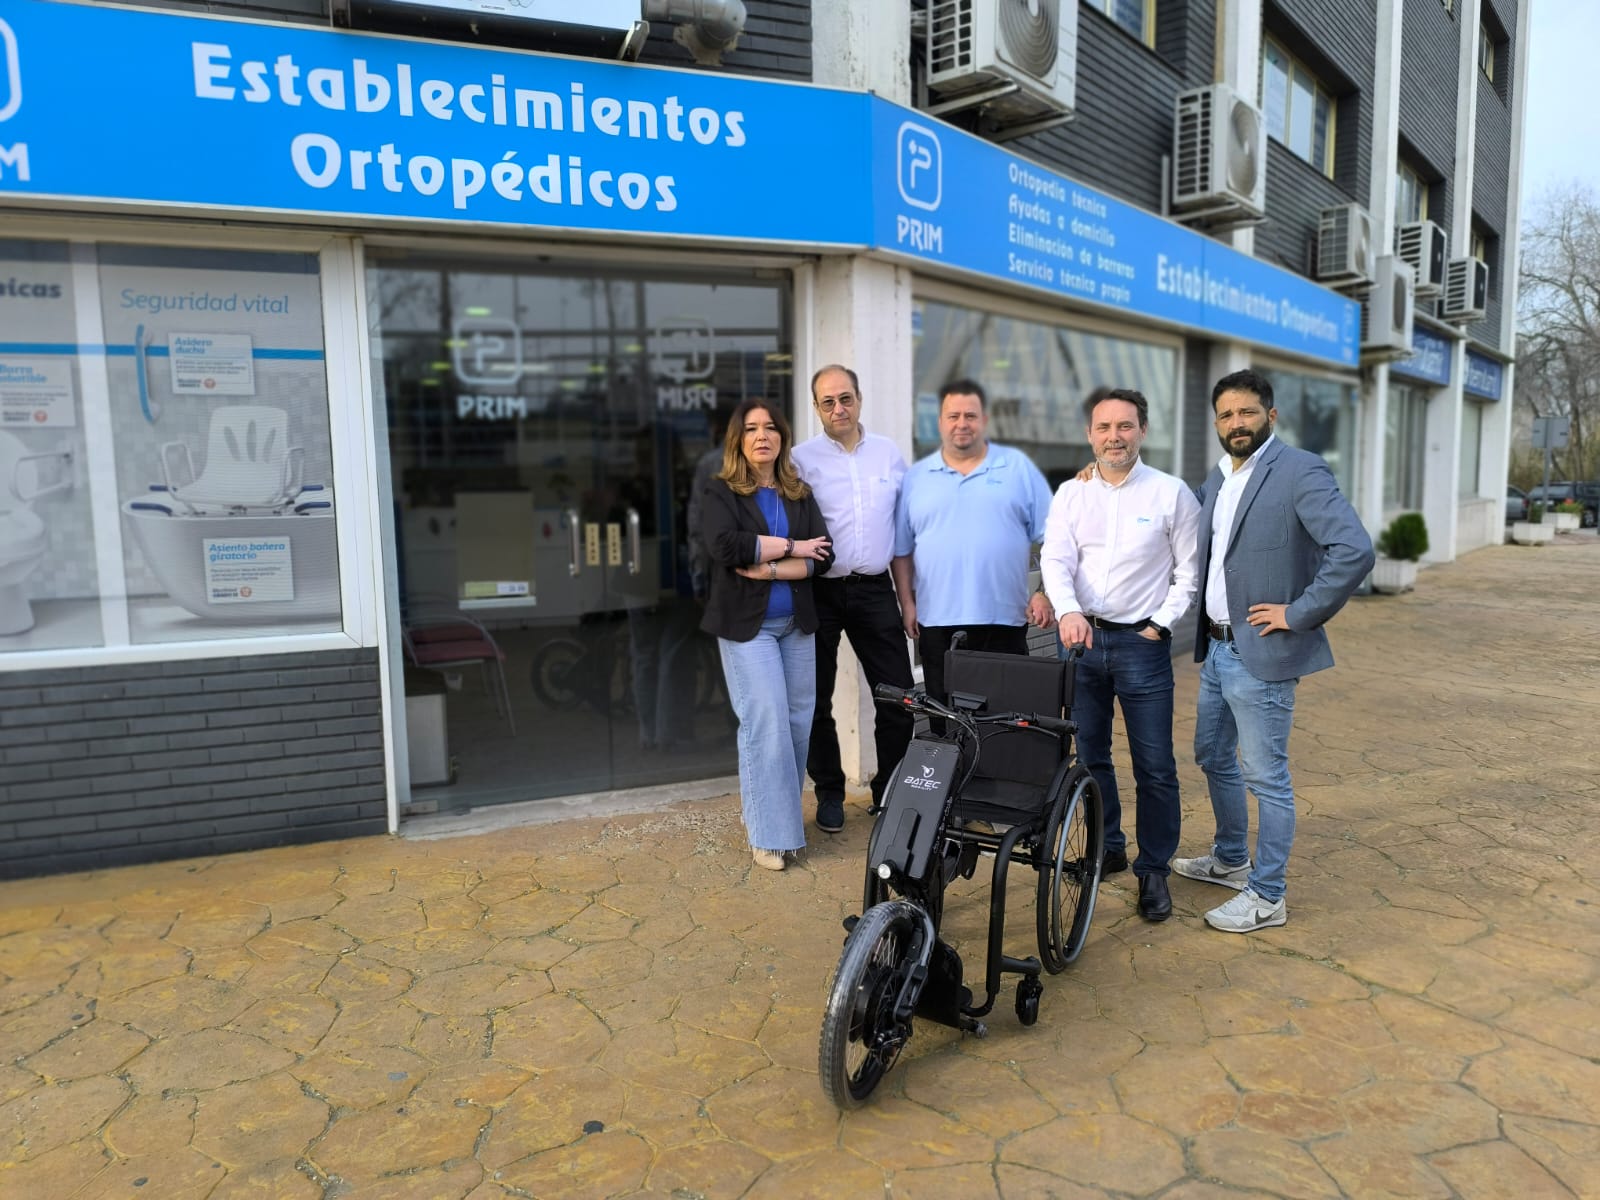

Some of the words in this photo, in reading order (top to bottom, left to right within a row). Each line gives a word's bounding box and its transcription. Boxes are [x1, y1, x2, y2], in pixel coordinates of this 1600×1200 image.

[192, 41, 747, 148] Establecimientos
[291, 132, 677, 211] Ortopédicos
[1009, 163, 1065, 202] Ortopedia
[897, 215, 942, 253] PRIM
[1009, 193, 1050, 224] Ayudas
[1057, 215, 1065, 230] a
[1071, 217, 1115, 248] domicilio
[1008, 252, 1054, 282] Servicio
[1102, 282, 1131, 303] propio
[1080, 247, 1092, 266] de
[1097, 252, 1135, 279] barreras
[120, 288, 238, 314] Seguridad
[243, 295, 289, 314] vital
[1157, 253, 1278, 325] Establecimientos
[457, 396, 527, 421] PRIM
[209, 543, 248, 552] Asiento
[209, 551, 257, 562] giratorio
[904, 776, 941, 789] BATEC
